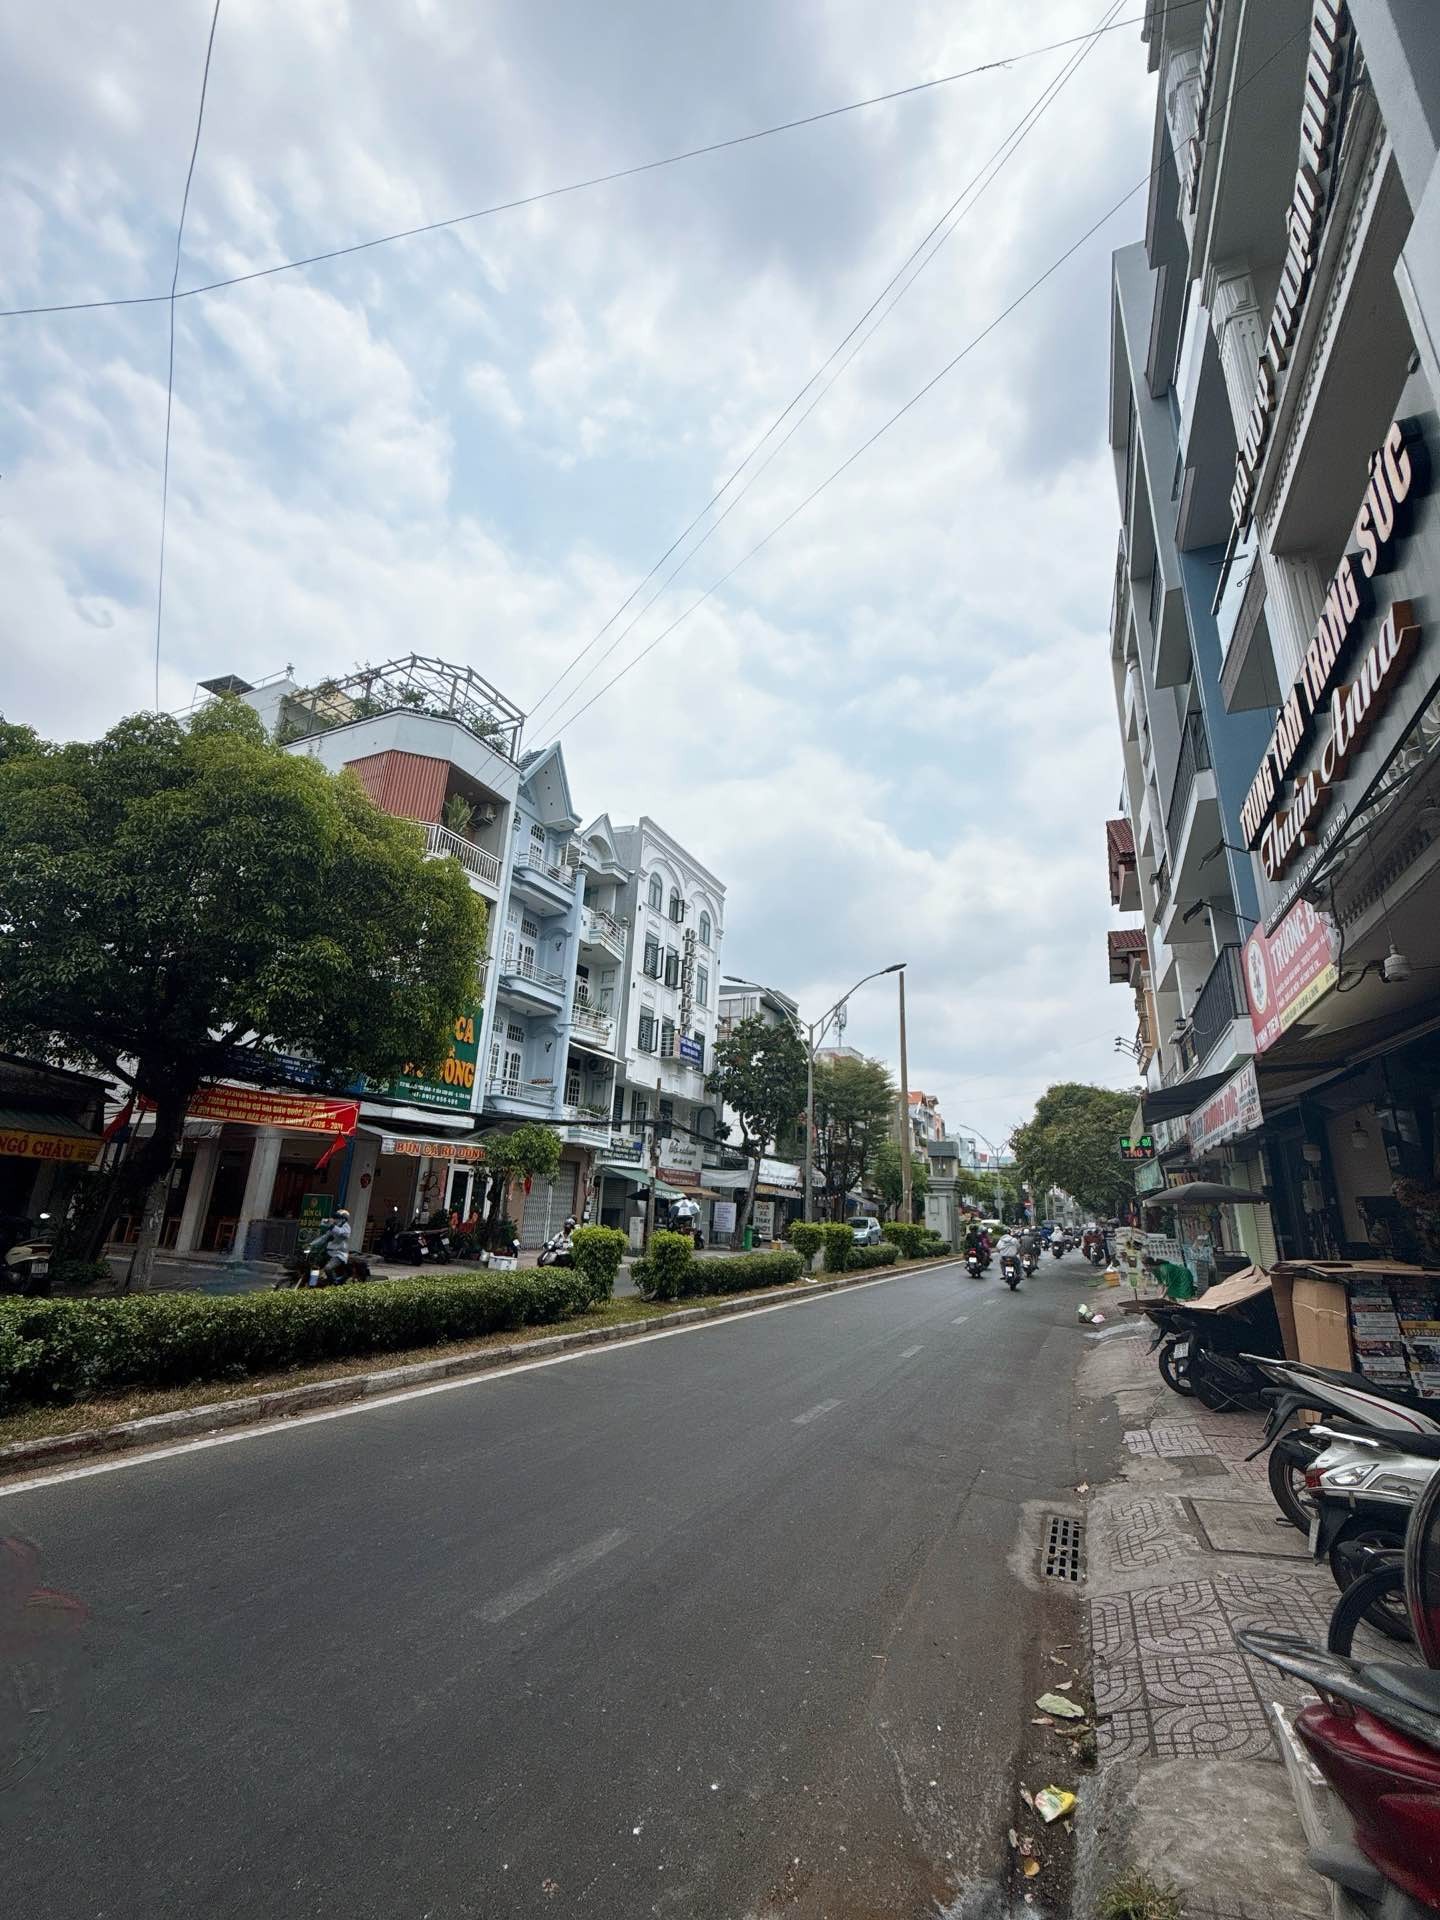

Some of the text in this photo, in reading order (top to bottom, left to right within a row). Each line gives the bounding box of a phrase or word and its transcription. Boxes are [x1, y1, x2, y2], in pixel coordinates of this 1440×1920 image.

[1264, 175, 1319, 374] THUẬN
[1300, 0, 1342, 173] ANN
[1240, 422, 1412, 849] TRUNG TÂM TRANG SỨC
[1259, 768, 1330, 882] Thuận
[1320, 606, 1418, 781] Anna
[32, 1139, 74, 1158] CHÂU
[395, 1140, 421, 1155] BÚN
